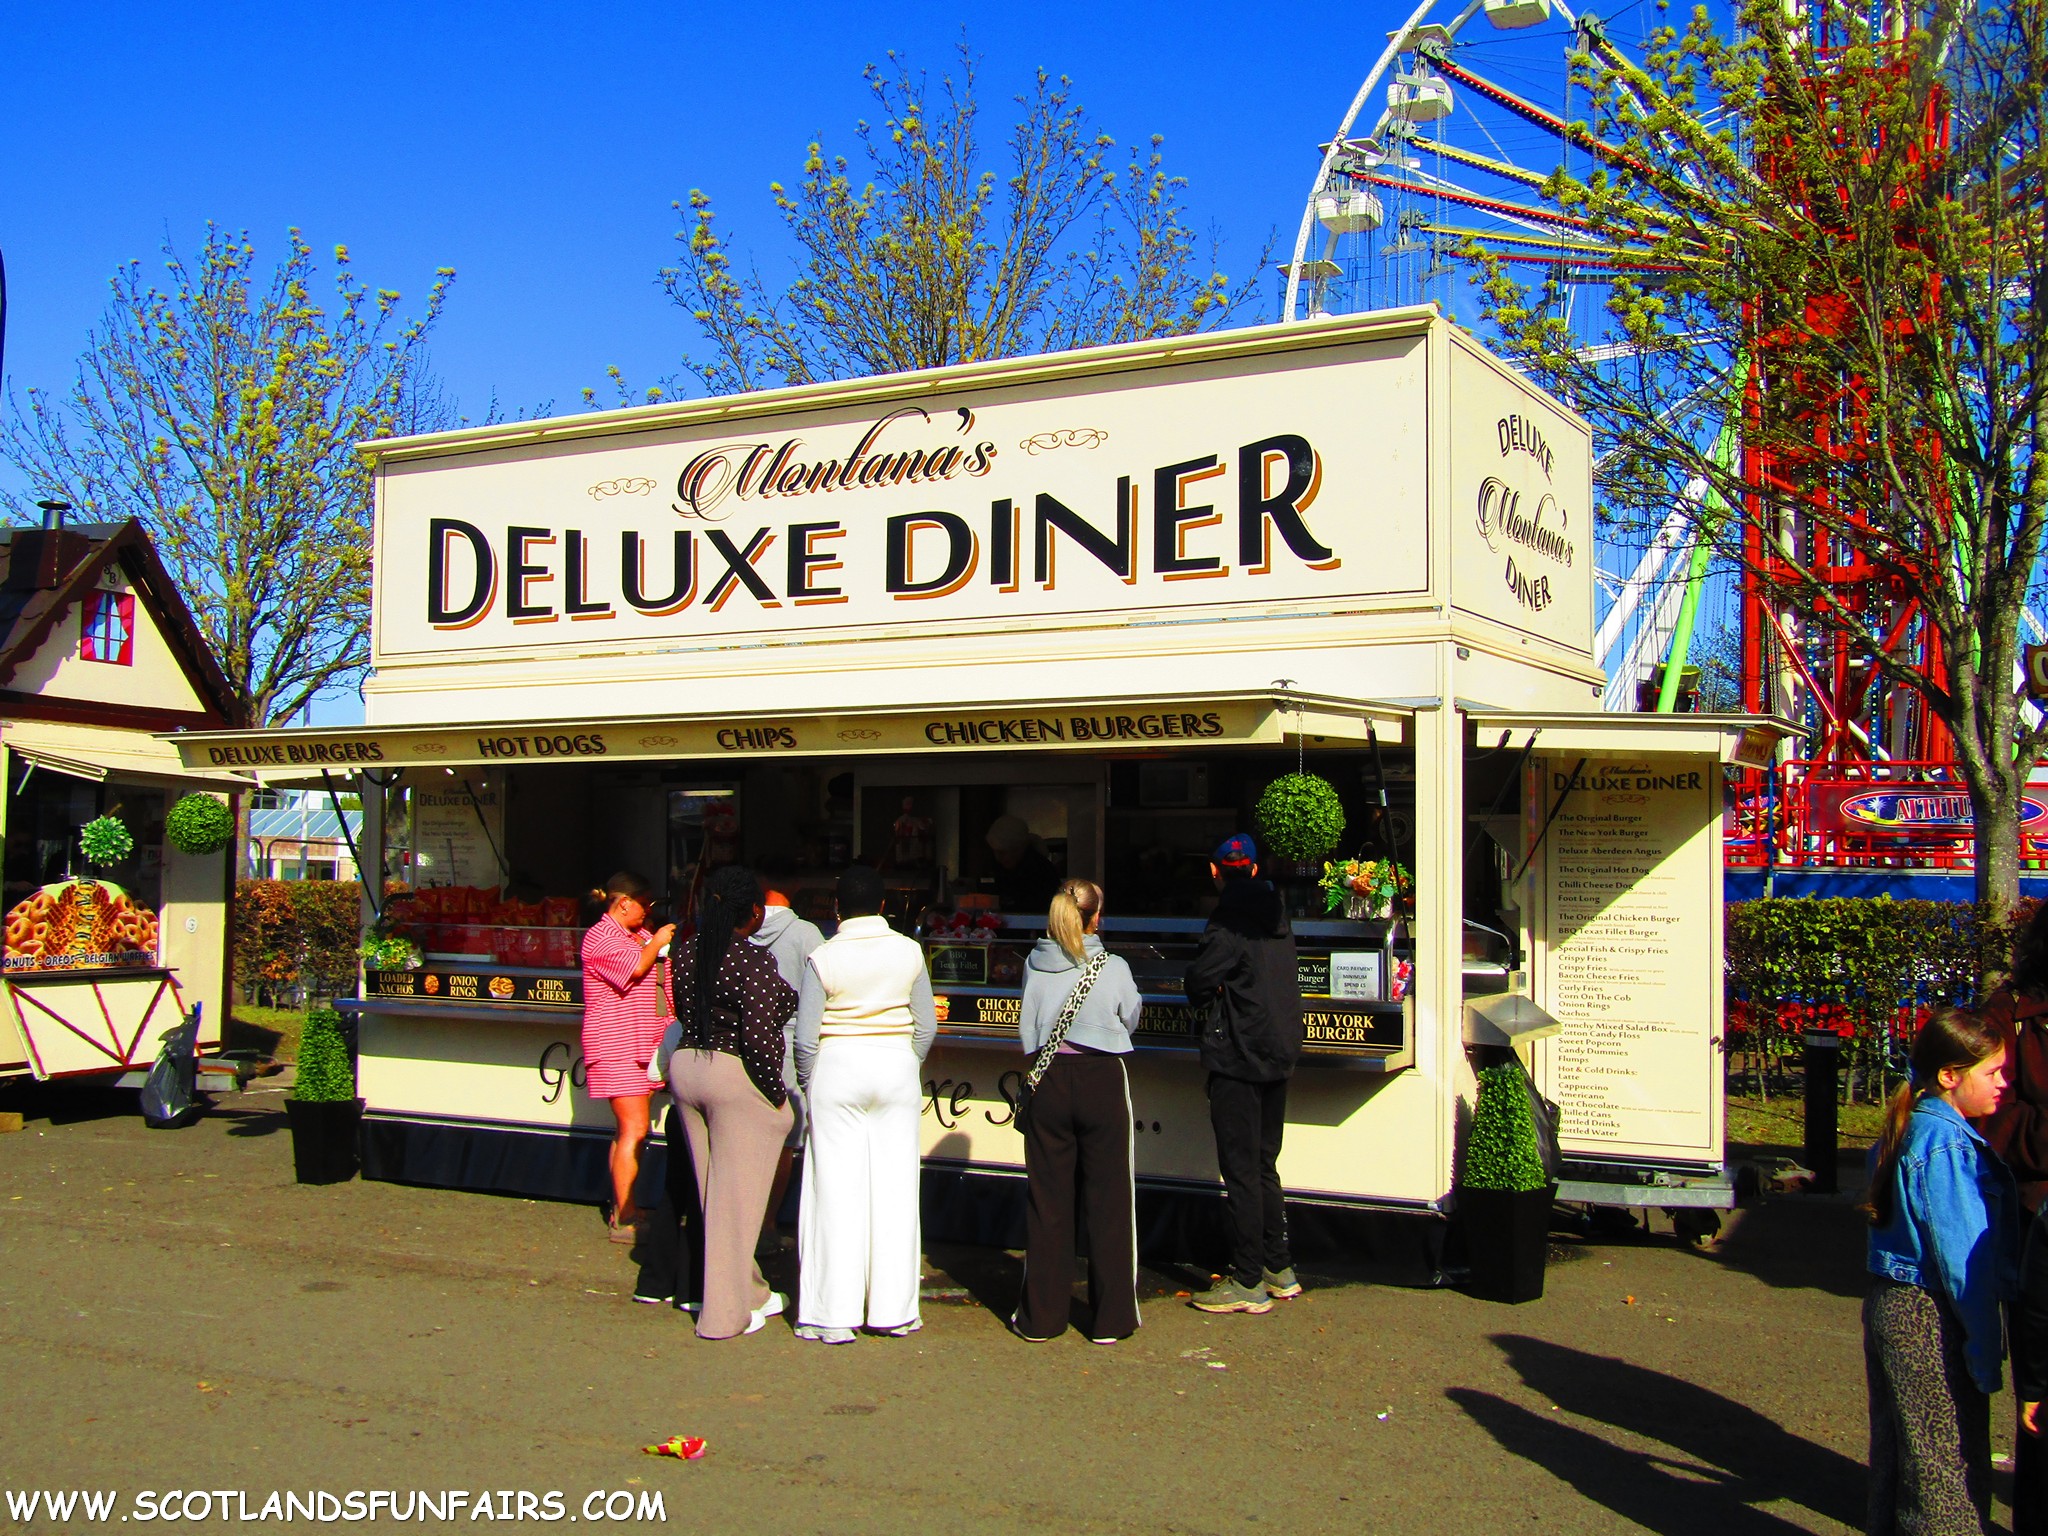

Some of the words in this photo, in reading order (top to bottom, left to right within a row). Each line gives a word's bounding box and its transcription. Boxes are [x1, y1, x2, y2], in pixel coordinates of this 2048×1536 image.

[1498, 414, 1554, 486] DELUXE
[671, 406, 998, 521] Montana's
[1476, 476, 1573, 567] Montana's
[428, 516, 849, 630] DELUXE
[885, 433, 1341, 600] DINER
[1505, 555, 1552, 612] DINER
[925, 718, 1065, 745] CHICKEN
[1071, 712, 1224, 741] BURGERS
[716, 727, 798, 751] CHIPS
[477, 736, 541, 758] HOT
[540, 733, 608, 756] DOGS
[208, 744, 287, 767] DELUXE
[288, 741, 384, 764] BURGERS
[1554, 772, 1630, 791] DELUXE
[1637, 772, 1702, 790] DINER
[420, 794, 461, 806] DELUXE
[462, 792, 497, 806] DNER
[1895, 796, 1974, 821] ALTITU
[1559, 814, 1576, 822] The
[1578, 814, 1611, 823] Original
[1613, 815, 1642, 823] Burger
[1598, 829, 1617, 837] York
[1619, 829, 1648, 838] Burger
[1559, 847, 1588, 855] Deluxe
[1591, 847, 1632, 855] Aberdeen
[1634, 848, 1662, 857] Angus
[1576, 866, 1611, 875] Original
[1613, 866, 1630, 874] Hot
[1631, 866, 1650, 875] Dog
[1559, 881, 1581, 889] Chilli
[1583, 881, 1613, 890] Cheese
[1616, 882, 1633, 891] Dog
[1579, 895, 1600, 904] Long
[1576, 914, 1612, 923] Original
[1613, 914, 1648, 922] Chicken
[1650, 915, 1680, 924] Burger
[1559, 927, 1577, 936] BBQ
[1605, 928, 1627, 936] Fillet
[1629, 929, 1658, 937] Burger
[950, 951, 967, 960] BBQ
[1559, 945, 1588, 955] Special
[1591, 945, 1608, 953] Fish
[1618, 946, 1645, 956] Crispy
[45, 954, 75, 966] OREOS
[84, 952, 120, 964] BELGIAN
[122, 950, 155, 962] WAFFLES
[1559, 954, 1585, 964] Crispy
[1559, 964, 1585, 973] Crispy
[1587, 964, 1607, 972] Fries
[379, 972, 414, 984] LOADED
[450, 975, 478, 986] ONION
[1298, 974, 1325, 984] Burger
[1559, 972, 1584, 980] Bacon
[1587, 973, 1617, 981] Cheese
[1619, 973, 1640, 981] Fries
[379, 984, 414, 995] NACHOS
[536, 979, 564, 991] CHIPS
[1559, 984, 1581, 993] Curly
[450, 986, 477, 998] RINGS
[528, 990, 535, 1000] N
[536, 990, 571, 1002] CHEESE
[1559, 992, 1579, 1000] Corn
[1581, 993, 1594, 1001] On
[1596, 993, 1612, 1001] The
[1613, 994, 1631, 1002] Cob
[977, 998, 1021, 1011] CHICKE
[1559, 1001, 1585, 1009] Onion
[1587, 1002, 1611, 1011] Rings
[979, 1010, 1019, 1024] BURGE
[1140, 1006, 1174, 1018] DEEN
[1333, 1014, 1375, 1028] YORK
[1595, 1023, 1624, 1031] Mixed
[1652, 1025, 1668, 1033] Box
[1307, 1026, 1365, 1041] BURGER
[1590, 1030, 1616, 1039] Candy
[1619, 1031, 1641, 1039] Floss
[1559, 1038, 1582, 1046] Sweet
[1585, 1039, 1621, 1048] Popcorn
[1559, 1046, 1585, 1055] Candy
[1587, 1047, 1629, 1056] Dummies
[1559, 1055, 1589, 1064] Flumps
[1584, 1066, 1604, 1074] Cold
[1606, 1067, 1638, 1076] Drinks:
[1559, 1073, 1580, 1081] Latte
[1559, 1082, 1608, 1092] Cappuccino
[1559, 1091, 1605, 1100] Americano
[1559, 1100, 1574, 1108] Hot
[1576, 1100, 1619, 1110] Chocolate
[1591, 1110, 1612, 1119] Cans
[1592, 1119, 1620, 1128] Drinks
[1591, 1128, 1618, 1137] Water
